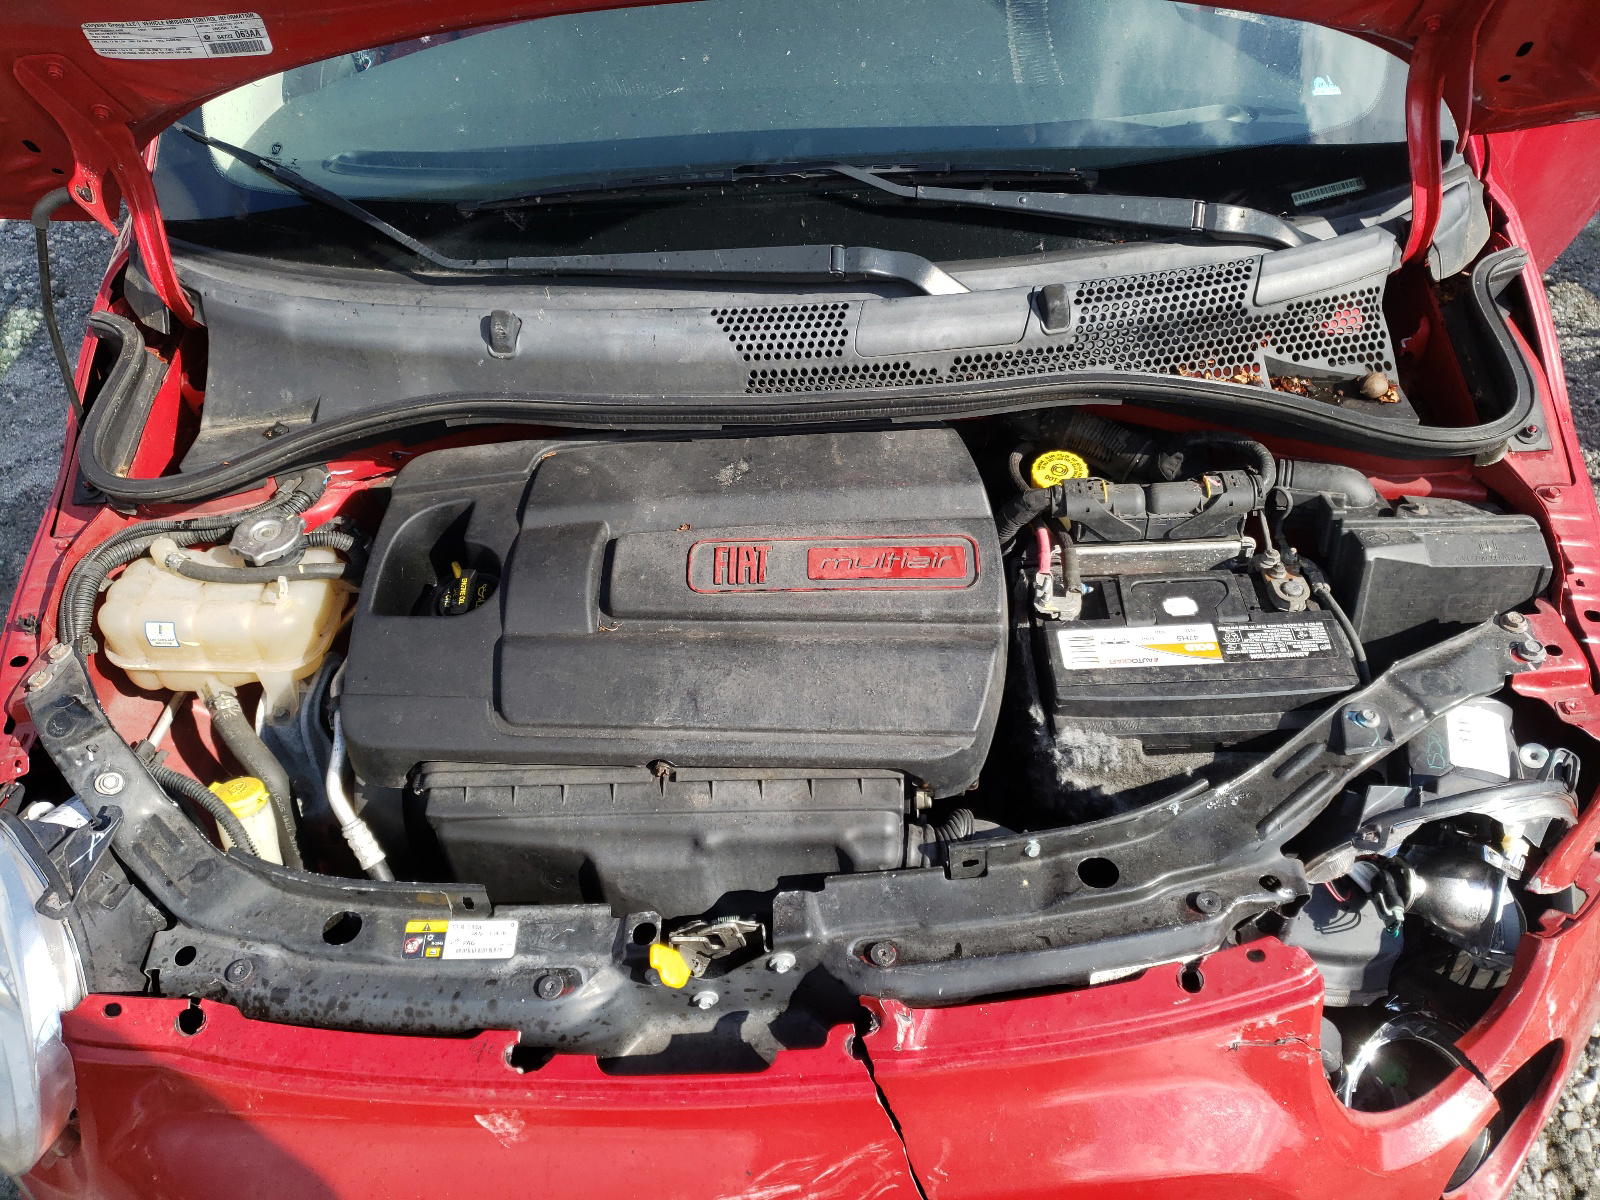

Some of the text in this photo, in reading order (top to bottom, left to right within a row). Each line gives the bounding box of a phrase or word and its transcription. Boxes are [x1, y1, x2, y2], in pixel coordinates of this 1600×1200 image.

[218, 12, 255, 21] INFORMATION
[234, 29, 262, 39] 063AA
[713, 545, 953, 585] FIAT multiair
